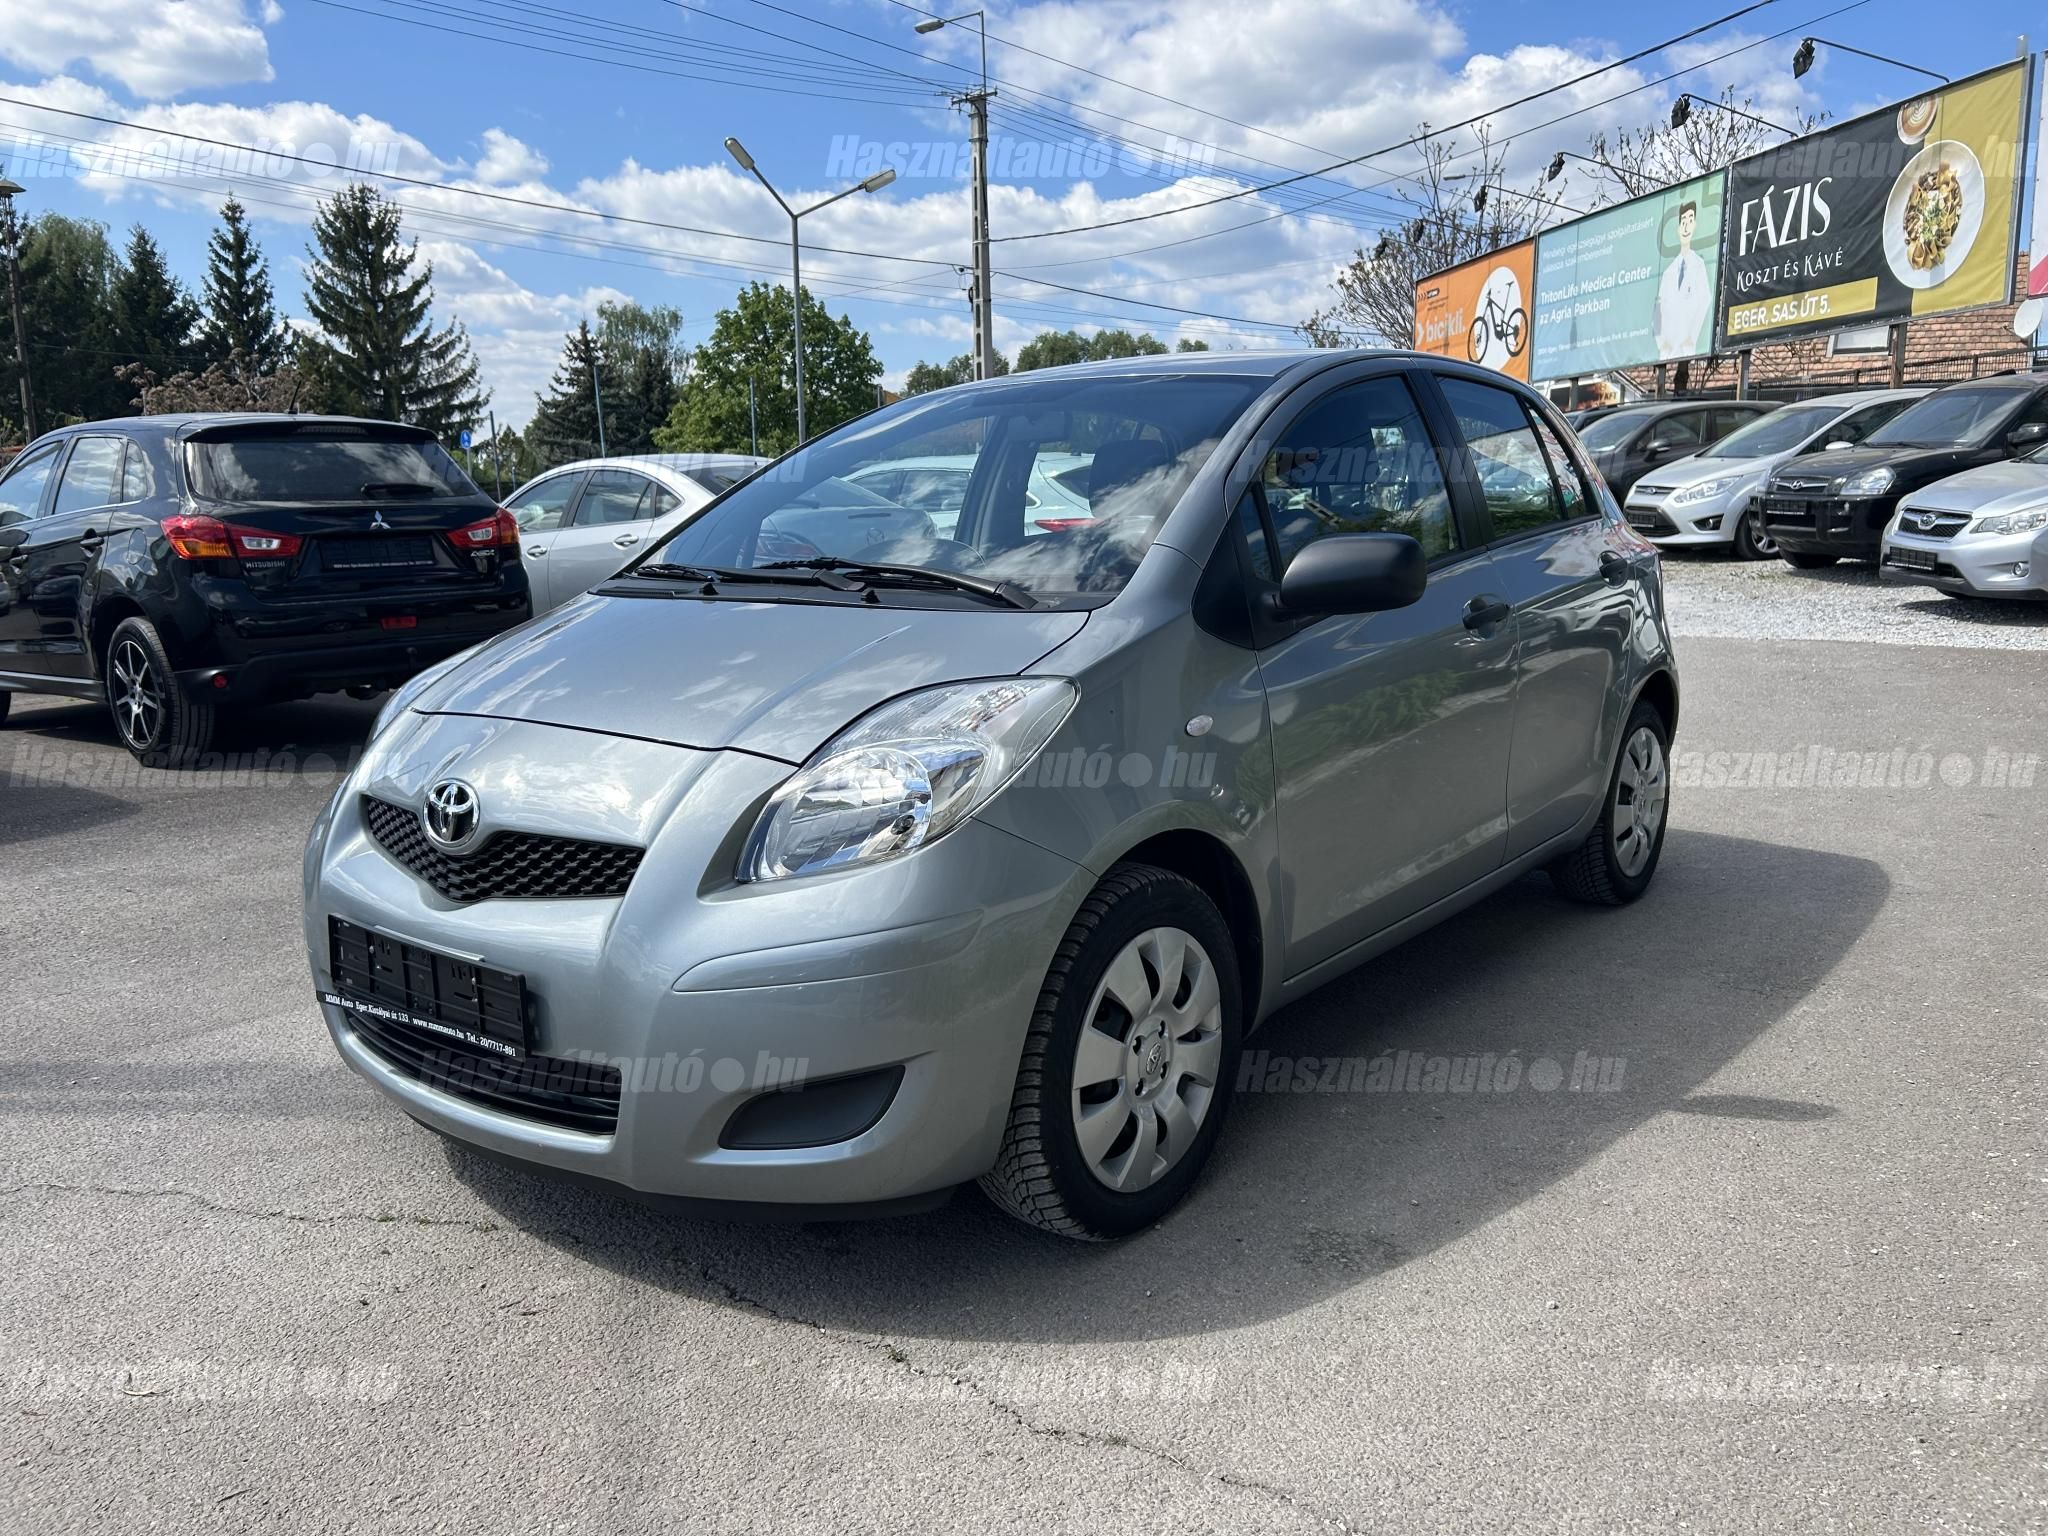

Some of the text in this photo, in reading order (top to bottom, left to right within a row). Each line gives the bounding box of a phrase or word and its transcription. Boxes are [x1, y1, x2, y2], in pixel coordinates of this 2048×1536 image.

[1739, 177, 1833, 256] FÁZIS
[1541, 266, 1652, 305] TritonLife Medical Center
[1539, 298, 1610, 325] az Agria Parkban
[1734, 308, 1769, 330] EGER,
[1771, 300, 1798, 323] SAS
[1801, 293, 1819, 318] ÚT
[246, 560, 286, 569] MITSUBISHI
